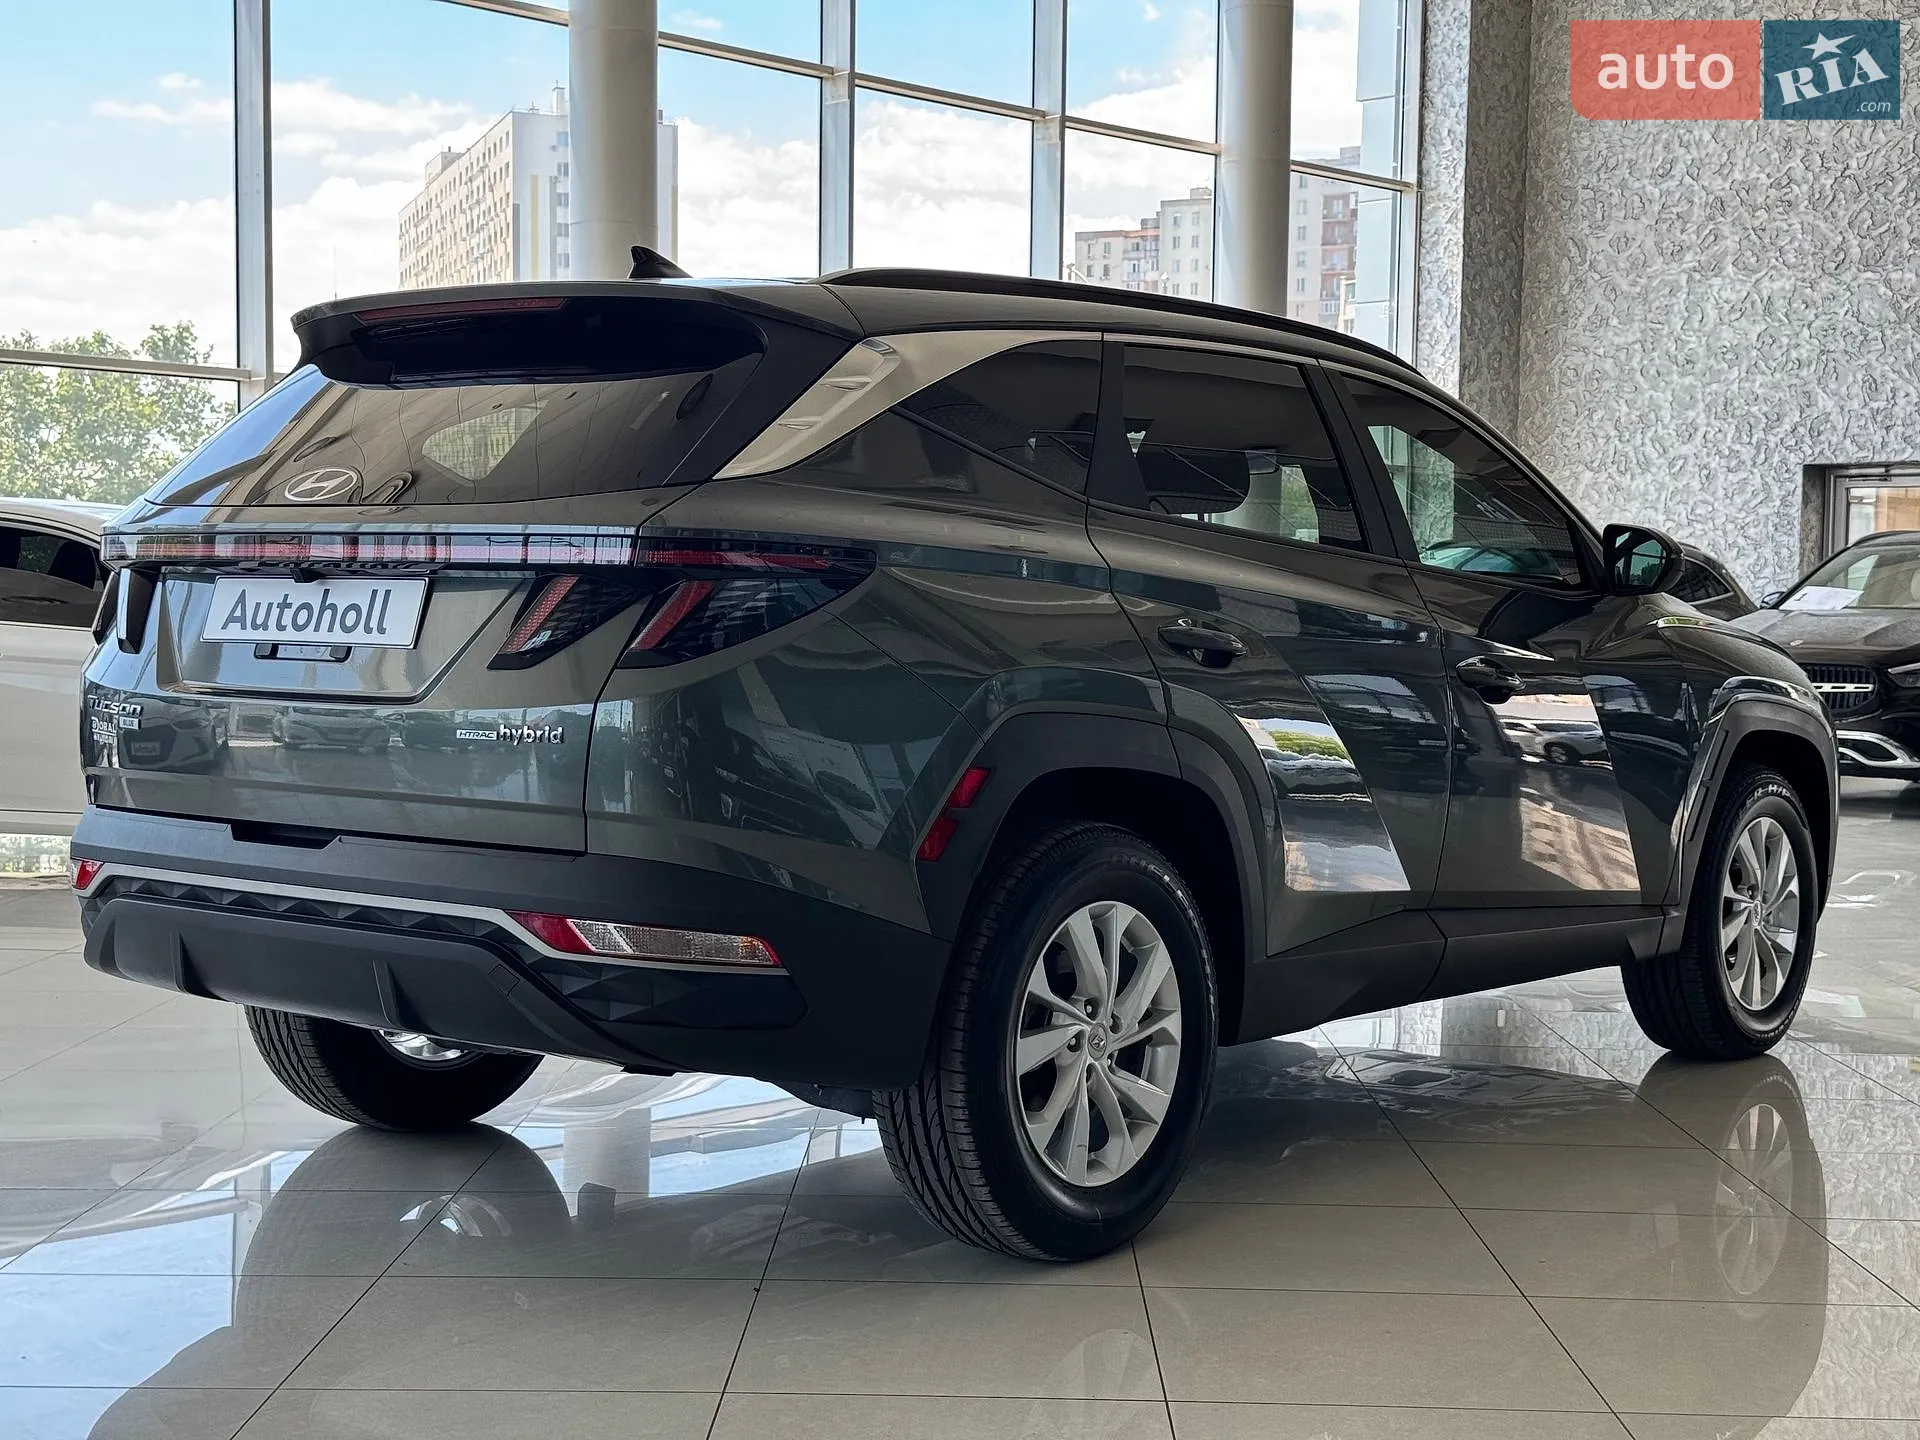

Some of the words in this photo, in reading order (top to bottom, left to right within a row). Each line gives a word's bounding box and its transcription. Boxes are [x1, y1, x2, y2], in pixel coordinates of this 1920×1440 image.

[220, 588, 392, 635] Autoholl
[459, 730, 496, 740] HTRAC
[500, 724, 564, 746] hybrid
